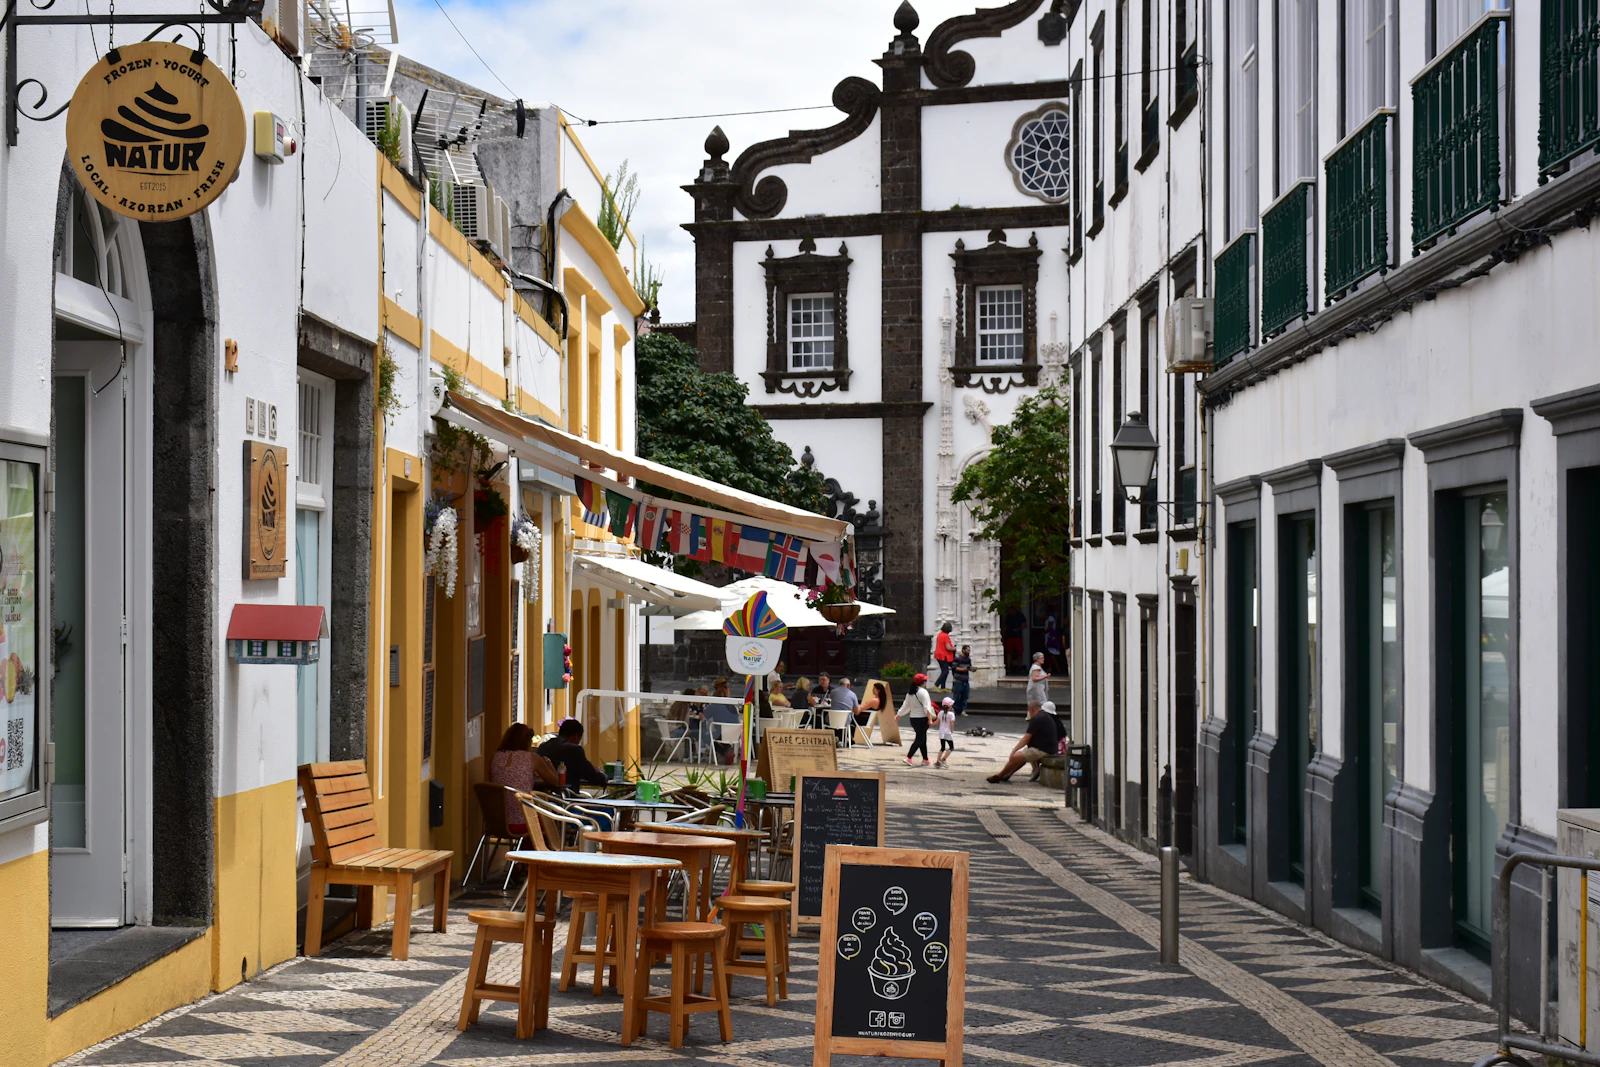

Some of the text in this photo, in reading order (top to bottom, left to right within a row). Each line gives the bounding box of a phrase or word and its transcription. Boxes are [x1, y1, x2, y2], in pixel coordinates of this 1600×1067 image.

[103, 58, 210, 88] FROZEN YOGURT
[103, 139, 206, 172] NATUR
[81, 155, 226, 213] LOCAL AZOREAN FRESH
[772, 735, 832, 746] CAFÉ CENTRAL
